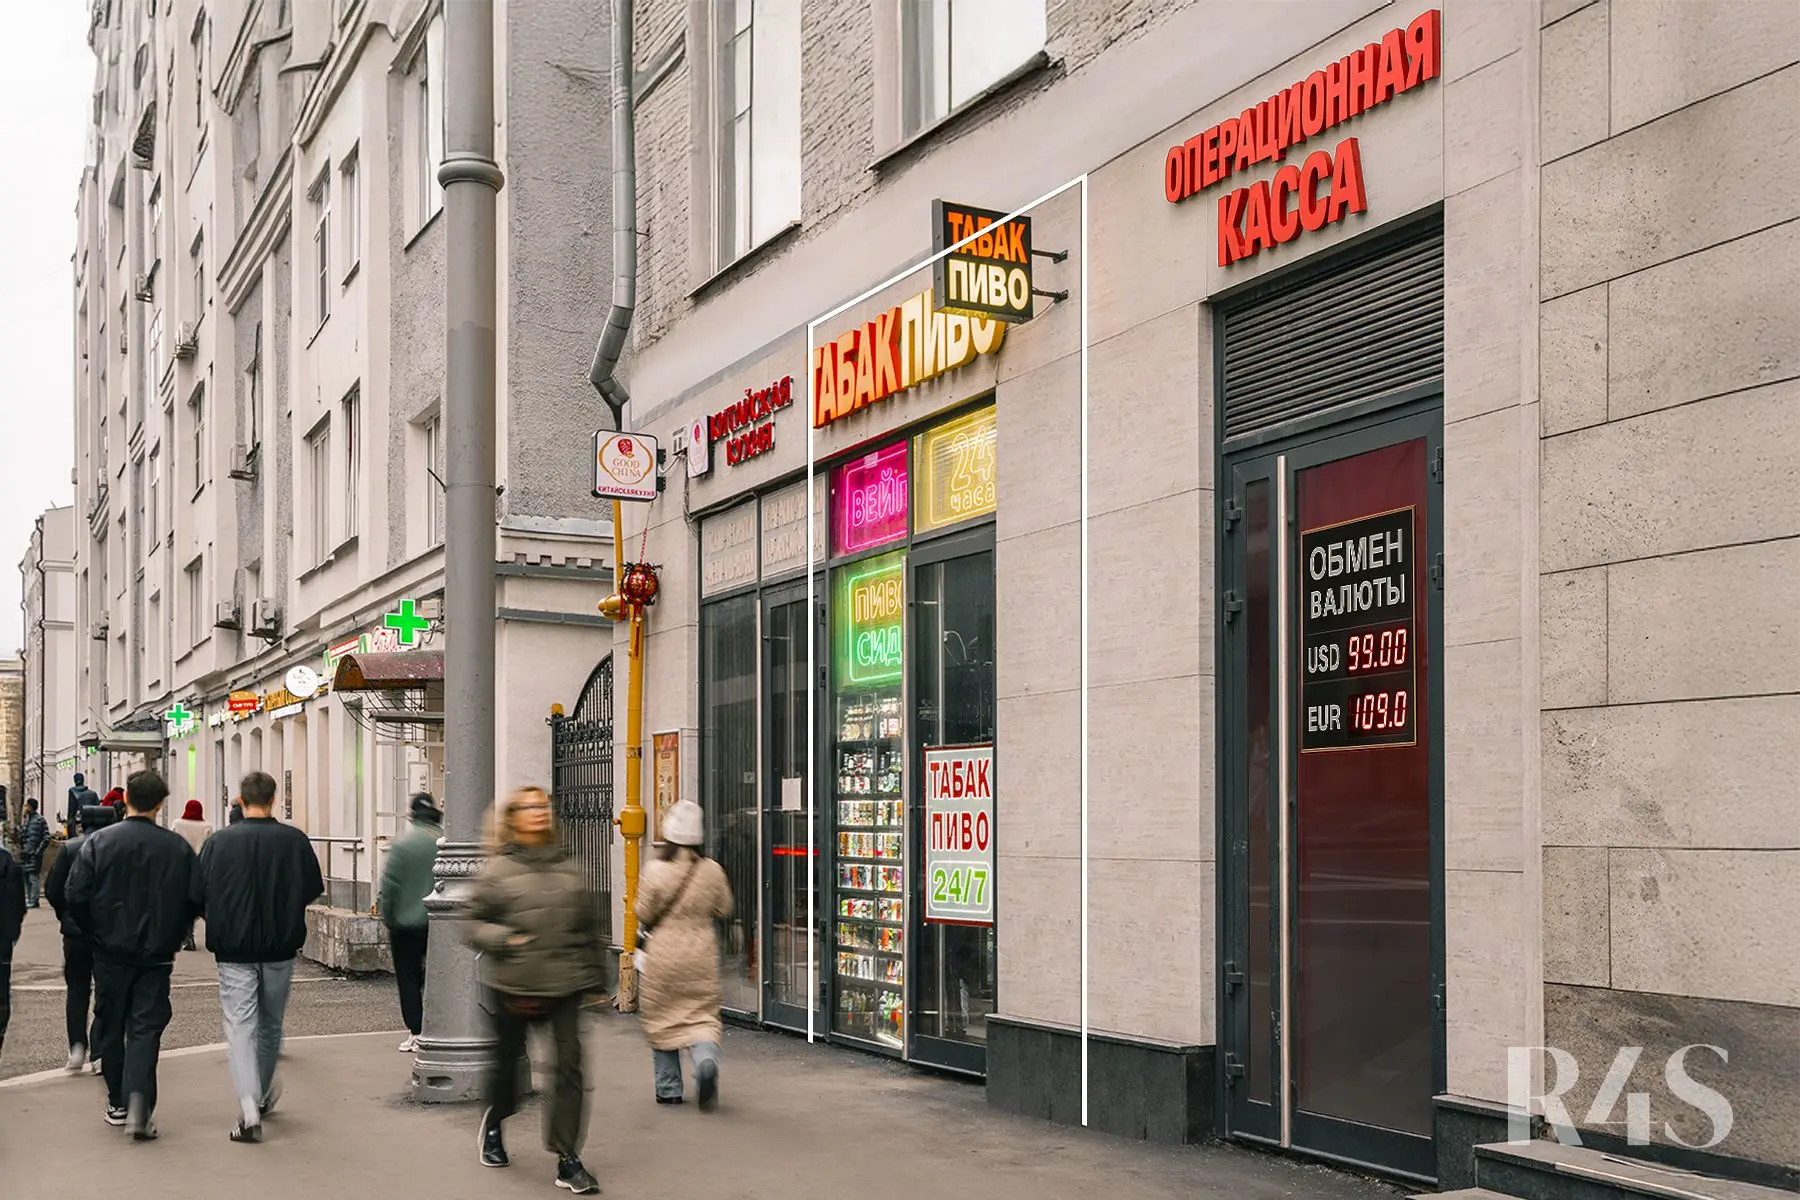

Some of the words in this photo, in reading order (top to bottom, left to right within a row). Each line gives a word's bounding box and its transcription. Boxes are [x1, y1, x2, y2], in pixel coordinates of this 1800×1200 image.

[1165, 9, 1440, 203] ОПЕРАЦИОННАЯ
[1218, 137, 1367, 267] КАССА
[948, 211, 1028, 264] ТАБАК
[949, 259, 1029, 311] ПИВО
[612, 458, 640, 469] GOOD
[612, 467, 641, 478] CHINA
[1310, 529, 1403, 580] ОБМЕН
[1310, 574, 1405, 619] ВАЛЮТЫ
[1308, 643, 1340, 674] USD
[1348, 628, 1407, 672] 99.00
[1308, 704, 1341, 732] EUR
[1354, 690, 1407, 730] 109.0
[930, 758, 991, 800] ТАБАК
[931, 811, 990, 852] ПИВО
[933, 868, 987, 905] 24/7
